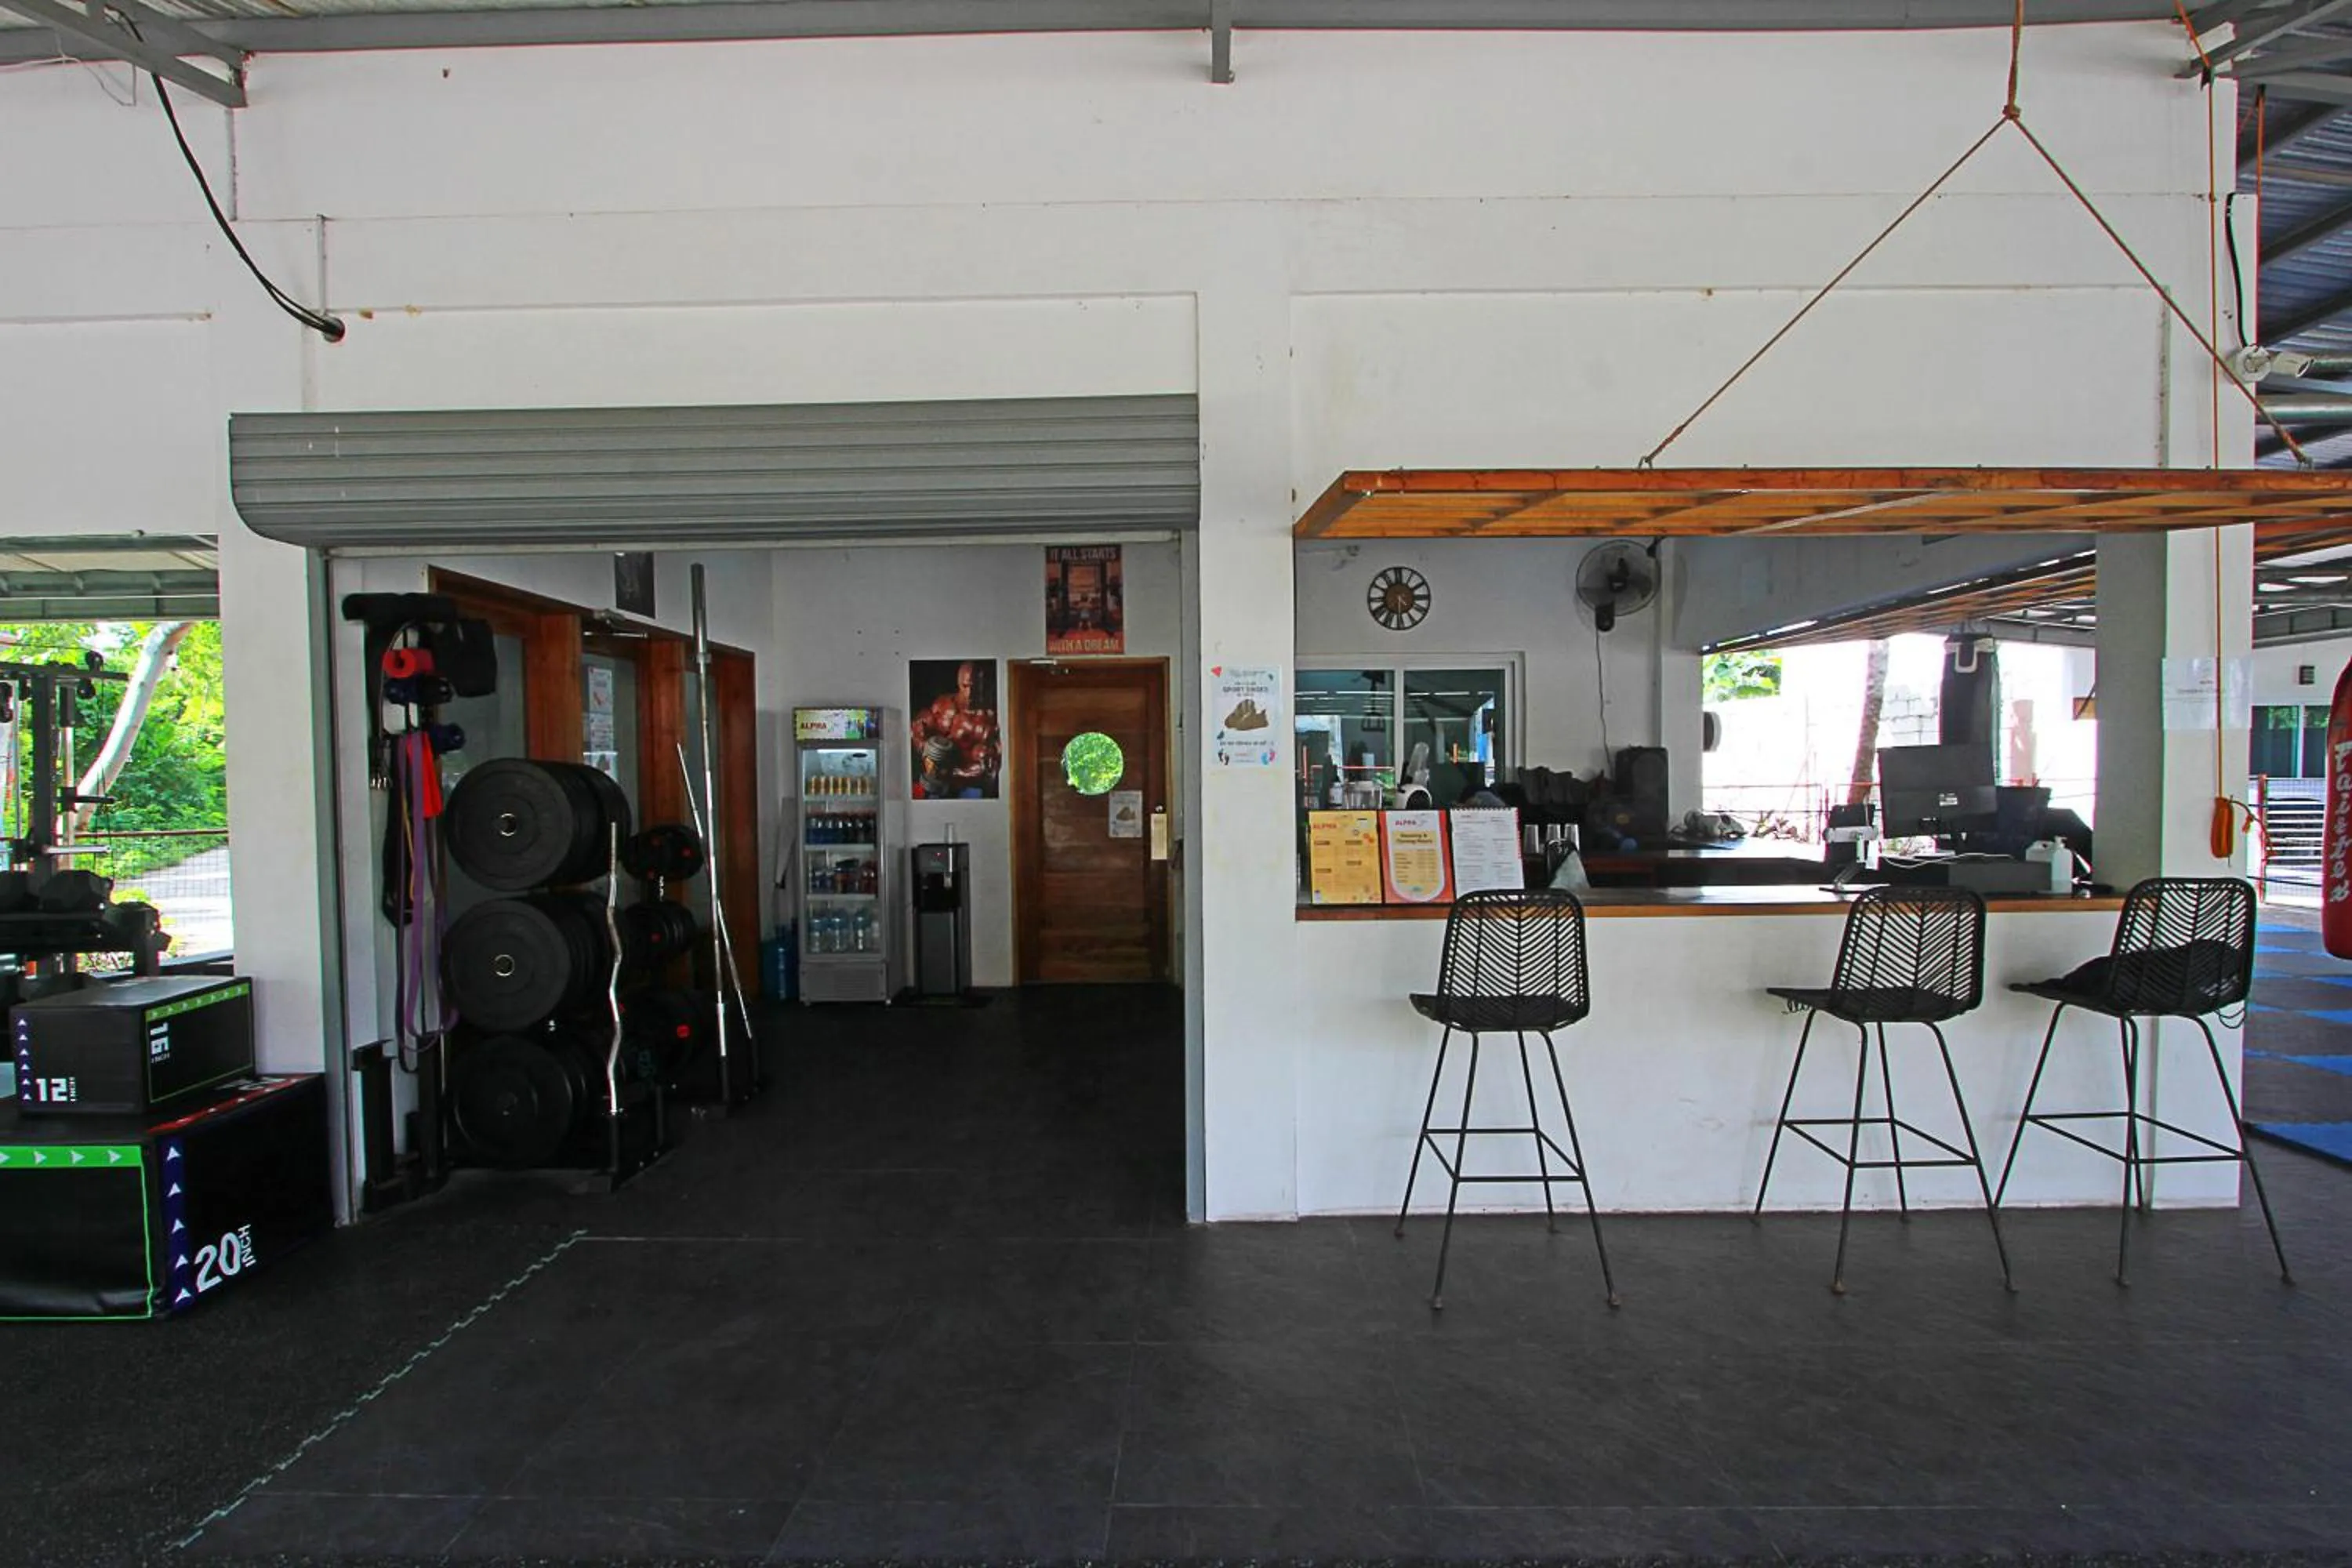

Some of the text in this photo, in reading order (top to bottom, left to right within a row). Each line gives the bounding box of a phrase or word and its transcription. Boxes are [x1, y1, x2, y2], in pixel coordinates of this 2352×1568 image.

[1082, 548, 1116, 560] STARTS
[150, 1022, 169, 1054] 16
[35, 1078, 67, 1102] 12
[194, 1224, 256, 1293] 20 INCH
